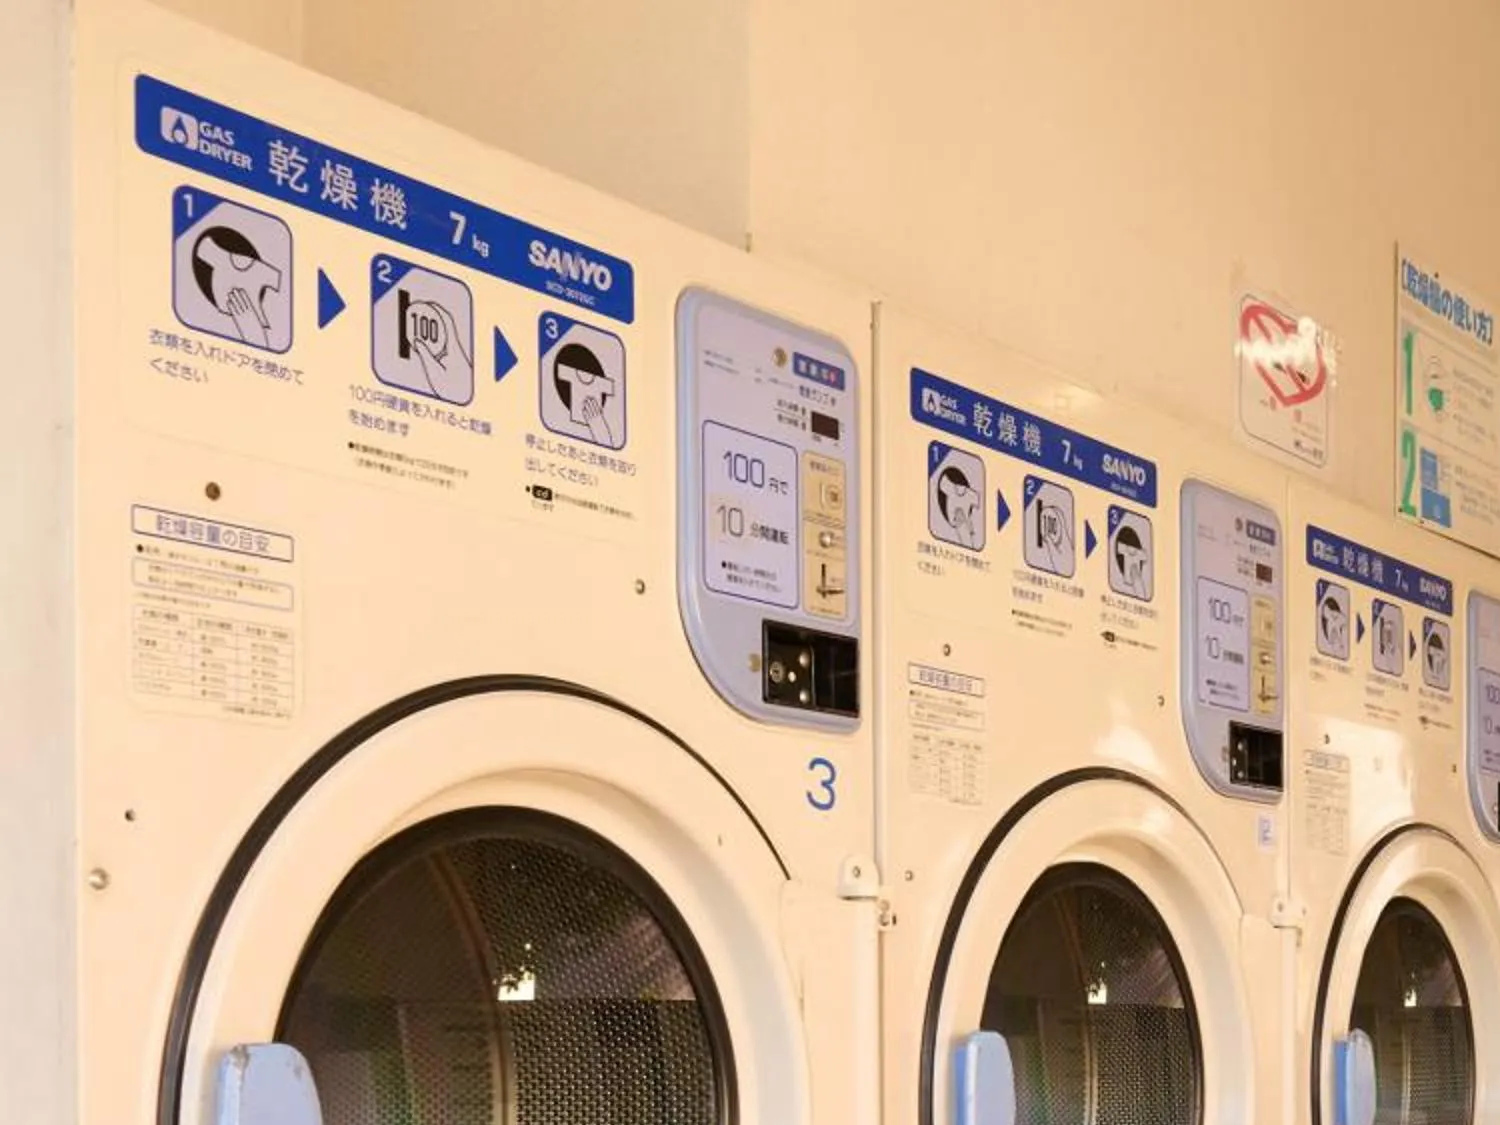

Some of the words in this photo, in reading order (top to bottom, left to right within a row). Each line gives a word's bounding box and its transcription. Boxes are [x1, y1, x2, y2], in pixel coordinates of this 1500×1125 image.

[200, 121, 235, 146] GAS
[199, 141, 254, 171] DRYER
[182, 193, 194, 218] 1
[267, 138, 408, 230] 乾燥機
[450, 211, 467, 245] 7
[472, 234, 490, 258] kg
[377, 260, 392, 284] 2
[528, 239, 613, 292] SANYO
[411, 312, 439, 344] 100
[545, 317, 559, 339] 3
[150, 357, 209, 384] ください
[1404, 329, 1414, 416] 1
[973, 401, 1041, 458] 乾燥機
[1061, 440, 1071, 465] 7
[1102, 453, 1147, 486] SANYO
[1402, 428, 1417, 518] 2
[1026, 480, 1035, 496] 2
[806, 757, 836, 811] 3
